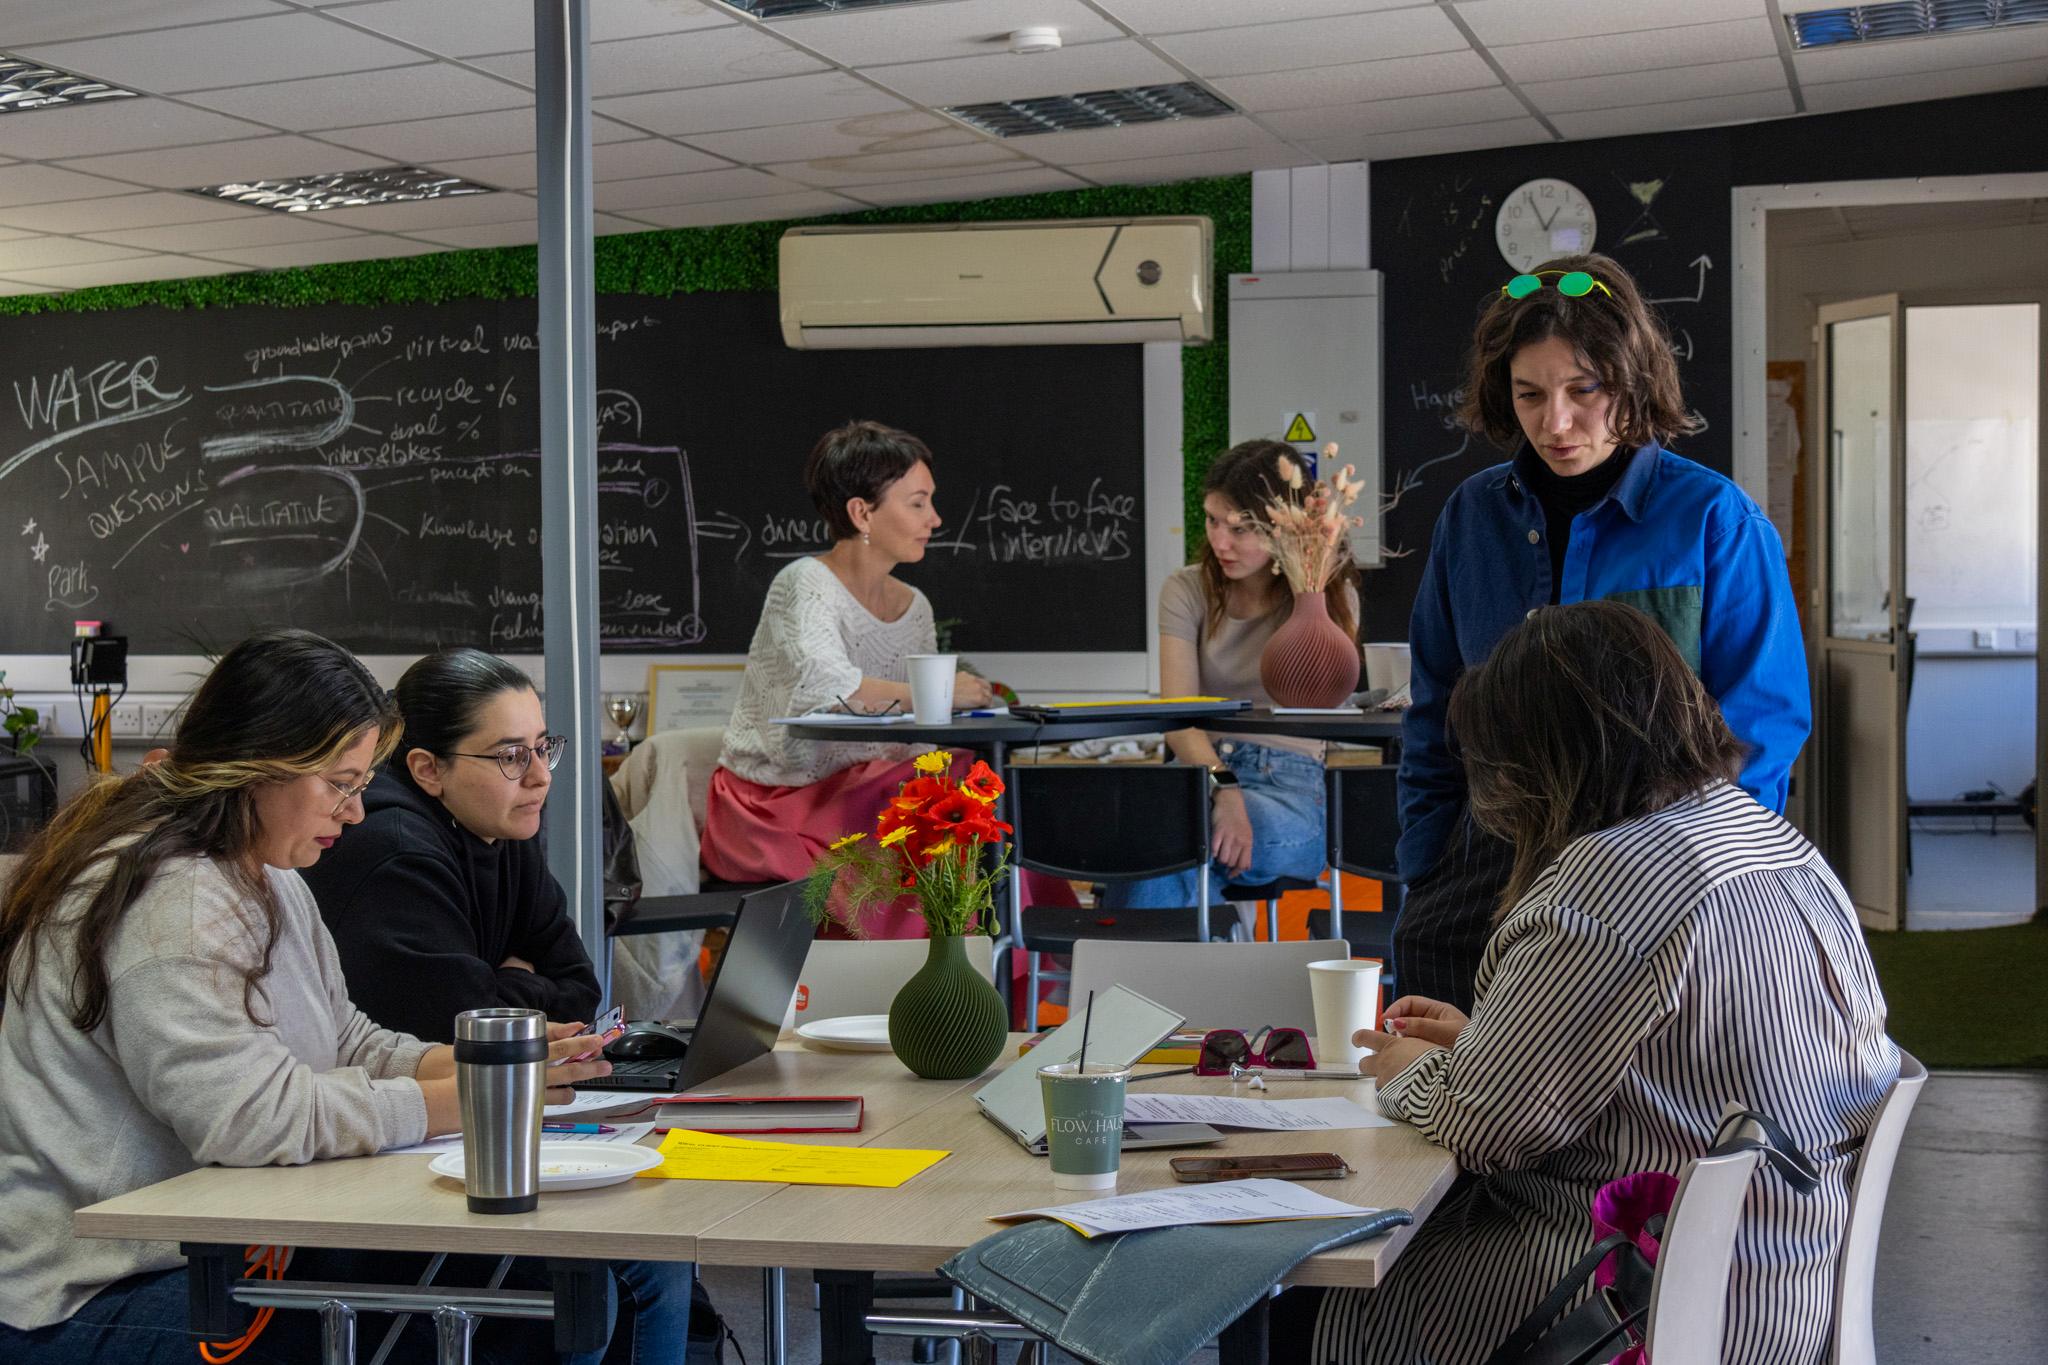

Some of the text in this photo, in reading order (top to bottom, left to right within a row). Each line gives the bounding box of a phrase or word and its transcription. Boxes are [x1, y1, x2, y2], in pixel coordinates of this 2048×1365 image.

[1539, 184, 1554, 199] 12
[1508, 206, 1522, 219] 10
[1575, 203, 1585, 217] 2
[406, 324, 489, 361] virtual
[14, 355, 186, 432] WATER
[397, 377, 481, 410] recycle
[456, 414, 482, 442] %
[55, 418, 188, 499] SAMPLE
[88, 470, 209, 539] QUESTIONS
[978, 477, 1140, 557] face to face
[1075, 1136, 1107, 1145] CAFE
